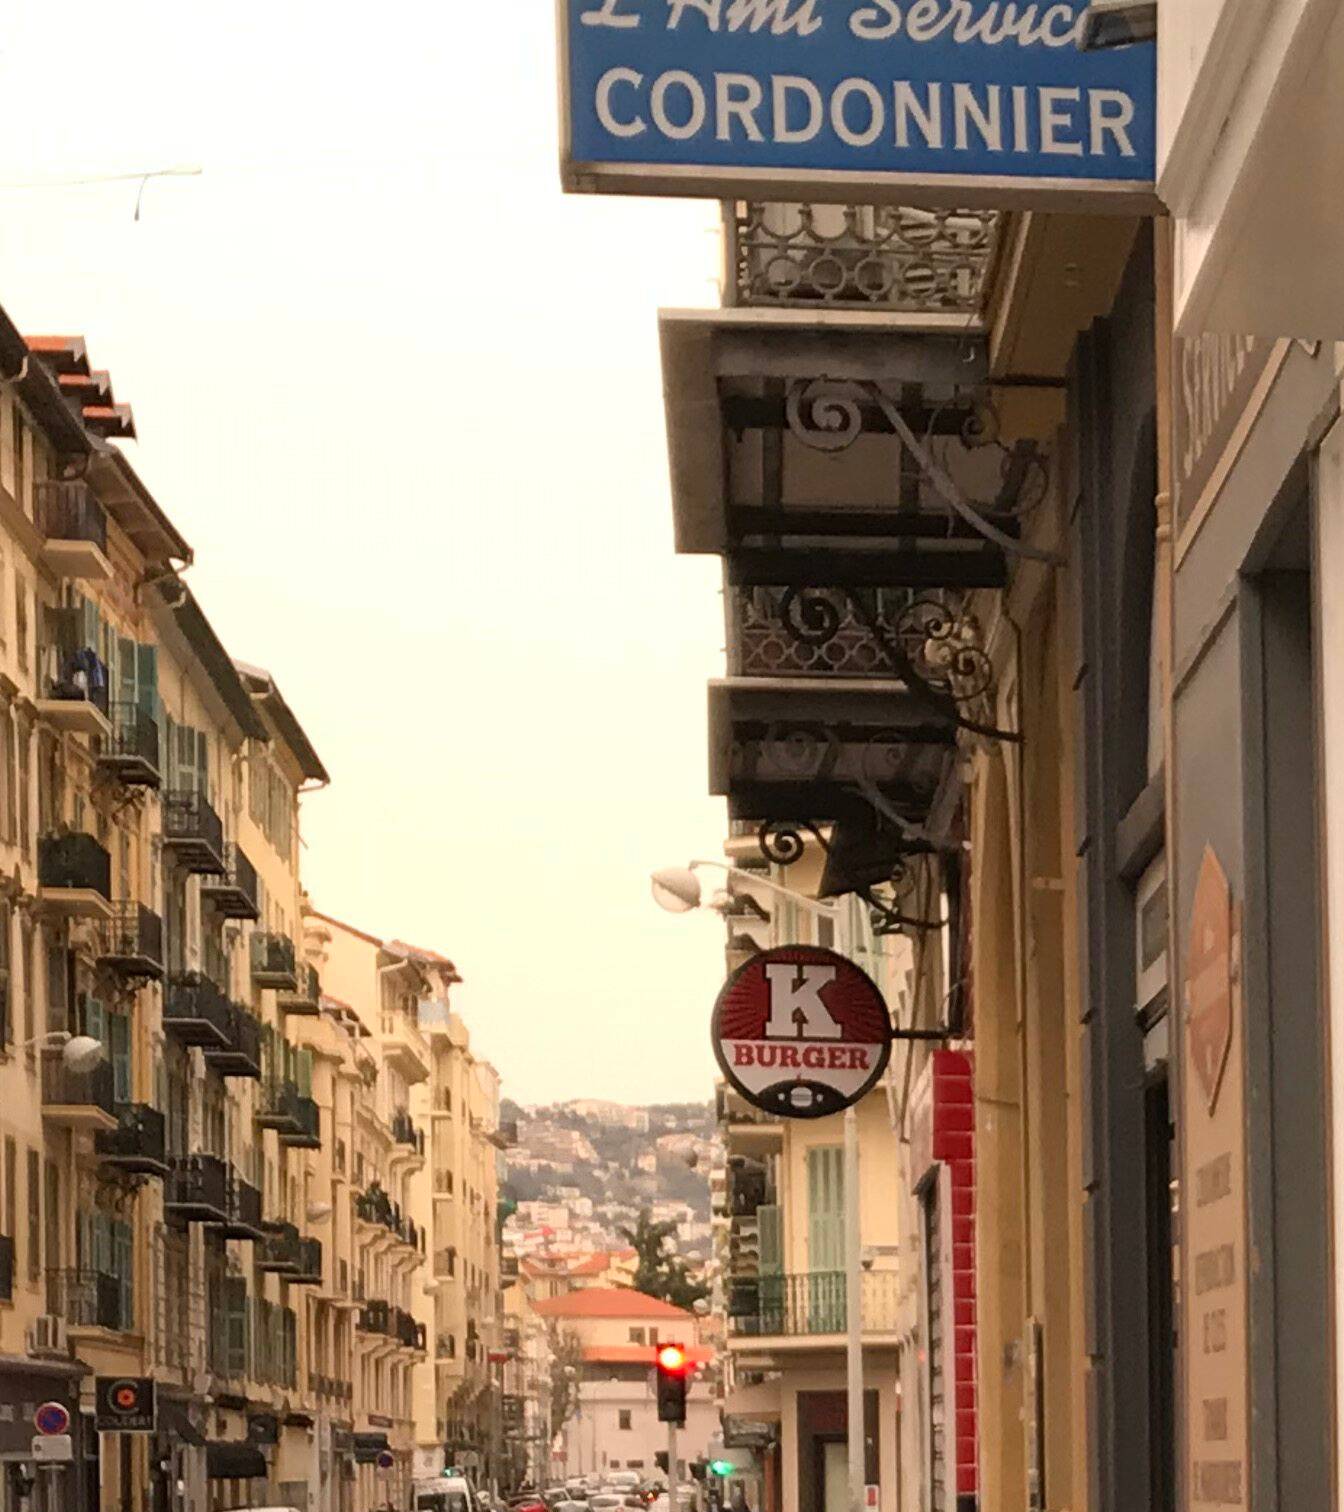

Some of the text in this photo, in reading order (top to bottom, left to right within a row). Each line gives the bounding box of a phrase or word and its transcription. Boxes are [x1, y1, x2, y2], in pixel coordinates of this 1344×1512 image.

[849, 0, 1129, 49] Servic
[595, 66, 1136, 158] CORDONNIER
[765, 963, 842, 1038] K
[733, 1043, 870, 1071] BURGER
